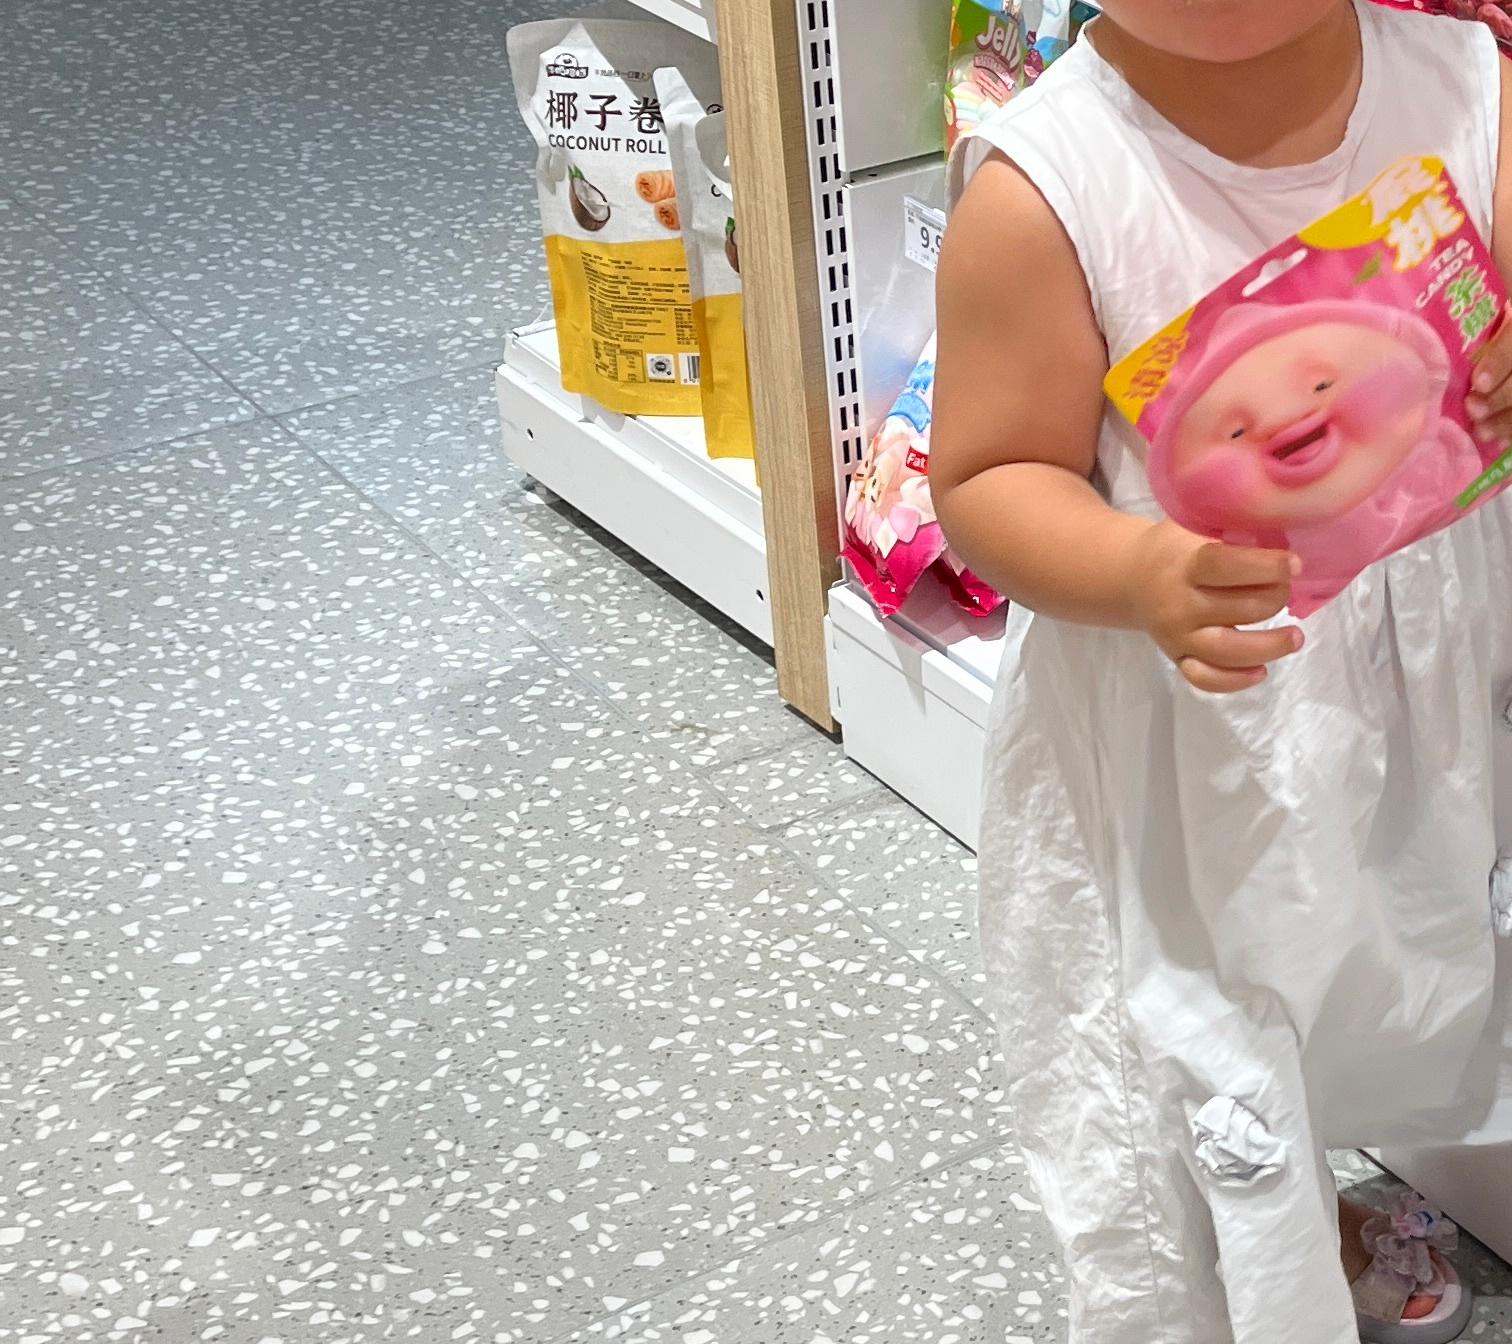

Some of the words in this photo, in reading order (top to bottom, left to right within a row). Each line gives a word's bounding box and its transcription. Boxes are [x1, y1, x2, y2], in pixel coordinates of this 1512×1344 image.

[544, 90, 665, 134] 椰子卷
[549, 134, 621, 151] COCONUT
[626, 139, 666, 154] ROLL
[1430, 239, 1474, 270] TEA
[1415, 250, 1476, 310] CANDY
